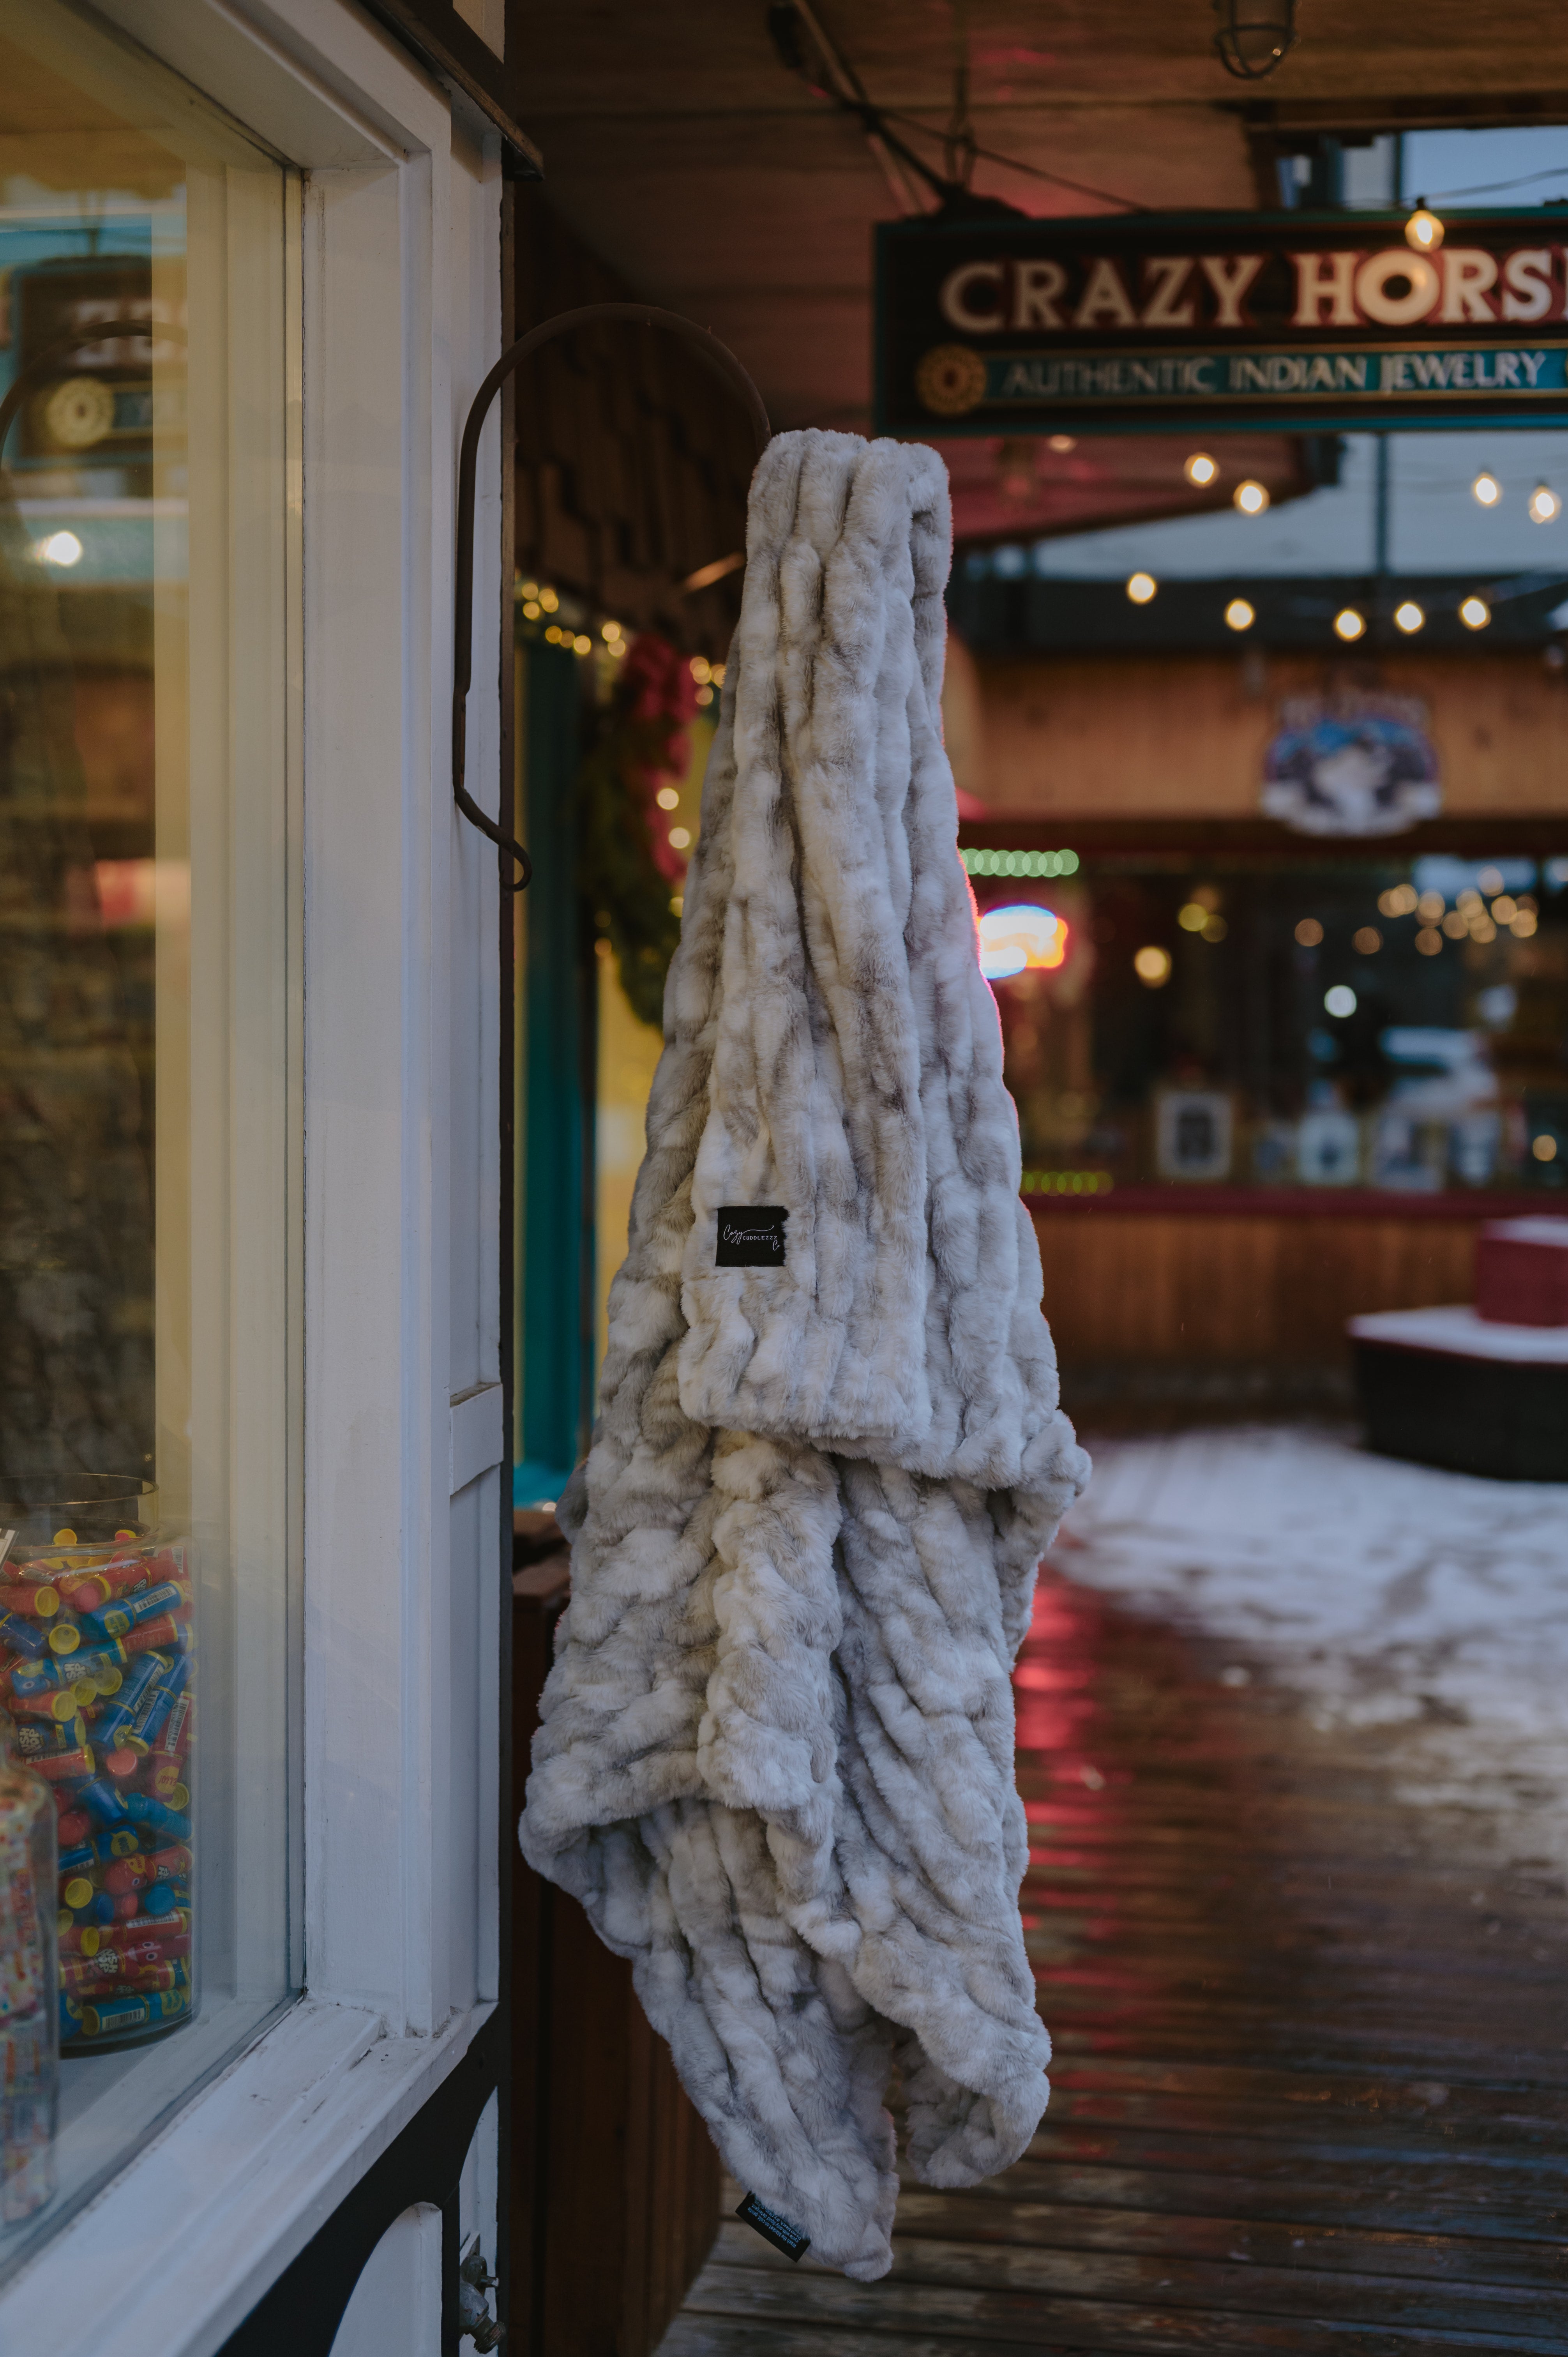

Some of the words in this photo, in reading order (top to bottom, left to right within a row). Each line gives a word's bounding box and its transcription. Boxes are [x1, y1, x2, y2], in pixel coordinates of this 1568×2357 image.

[940, 254, 1264, 334] CRAZY
[1291, 248, 1568, 327] HORS
[1001, 355, 1215, 395] AUTHENTIC
[1228, 354, 1367, 390] INDIAN
[1379, 352, 1546, 395] JEWELRY
[748, 2207, 758, 2216] gentle
[766, 2217, 776, 2225] liquid
[769, 2225, 782, 2237] blanket
[787, 2239, 796, 2248] Wash
